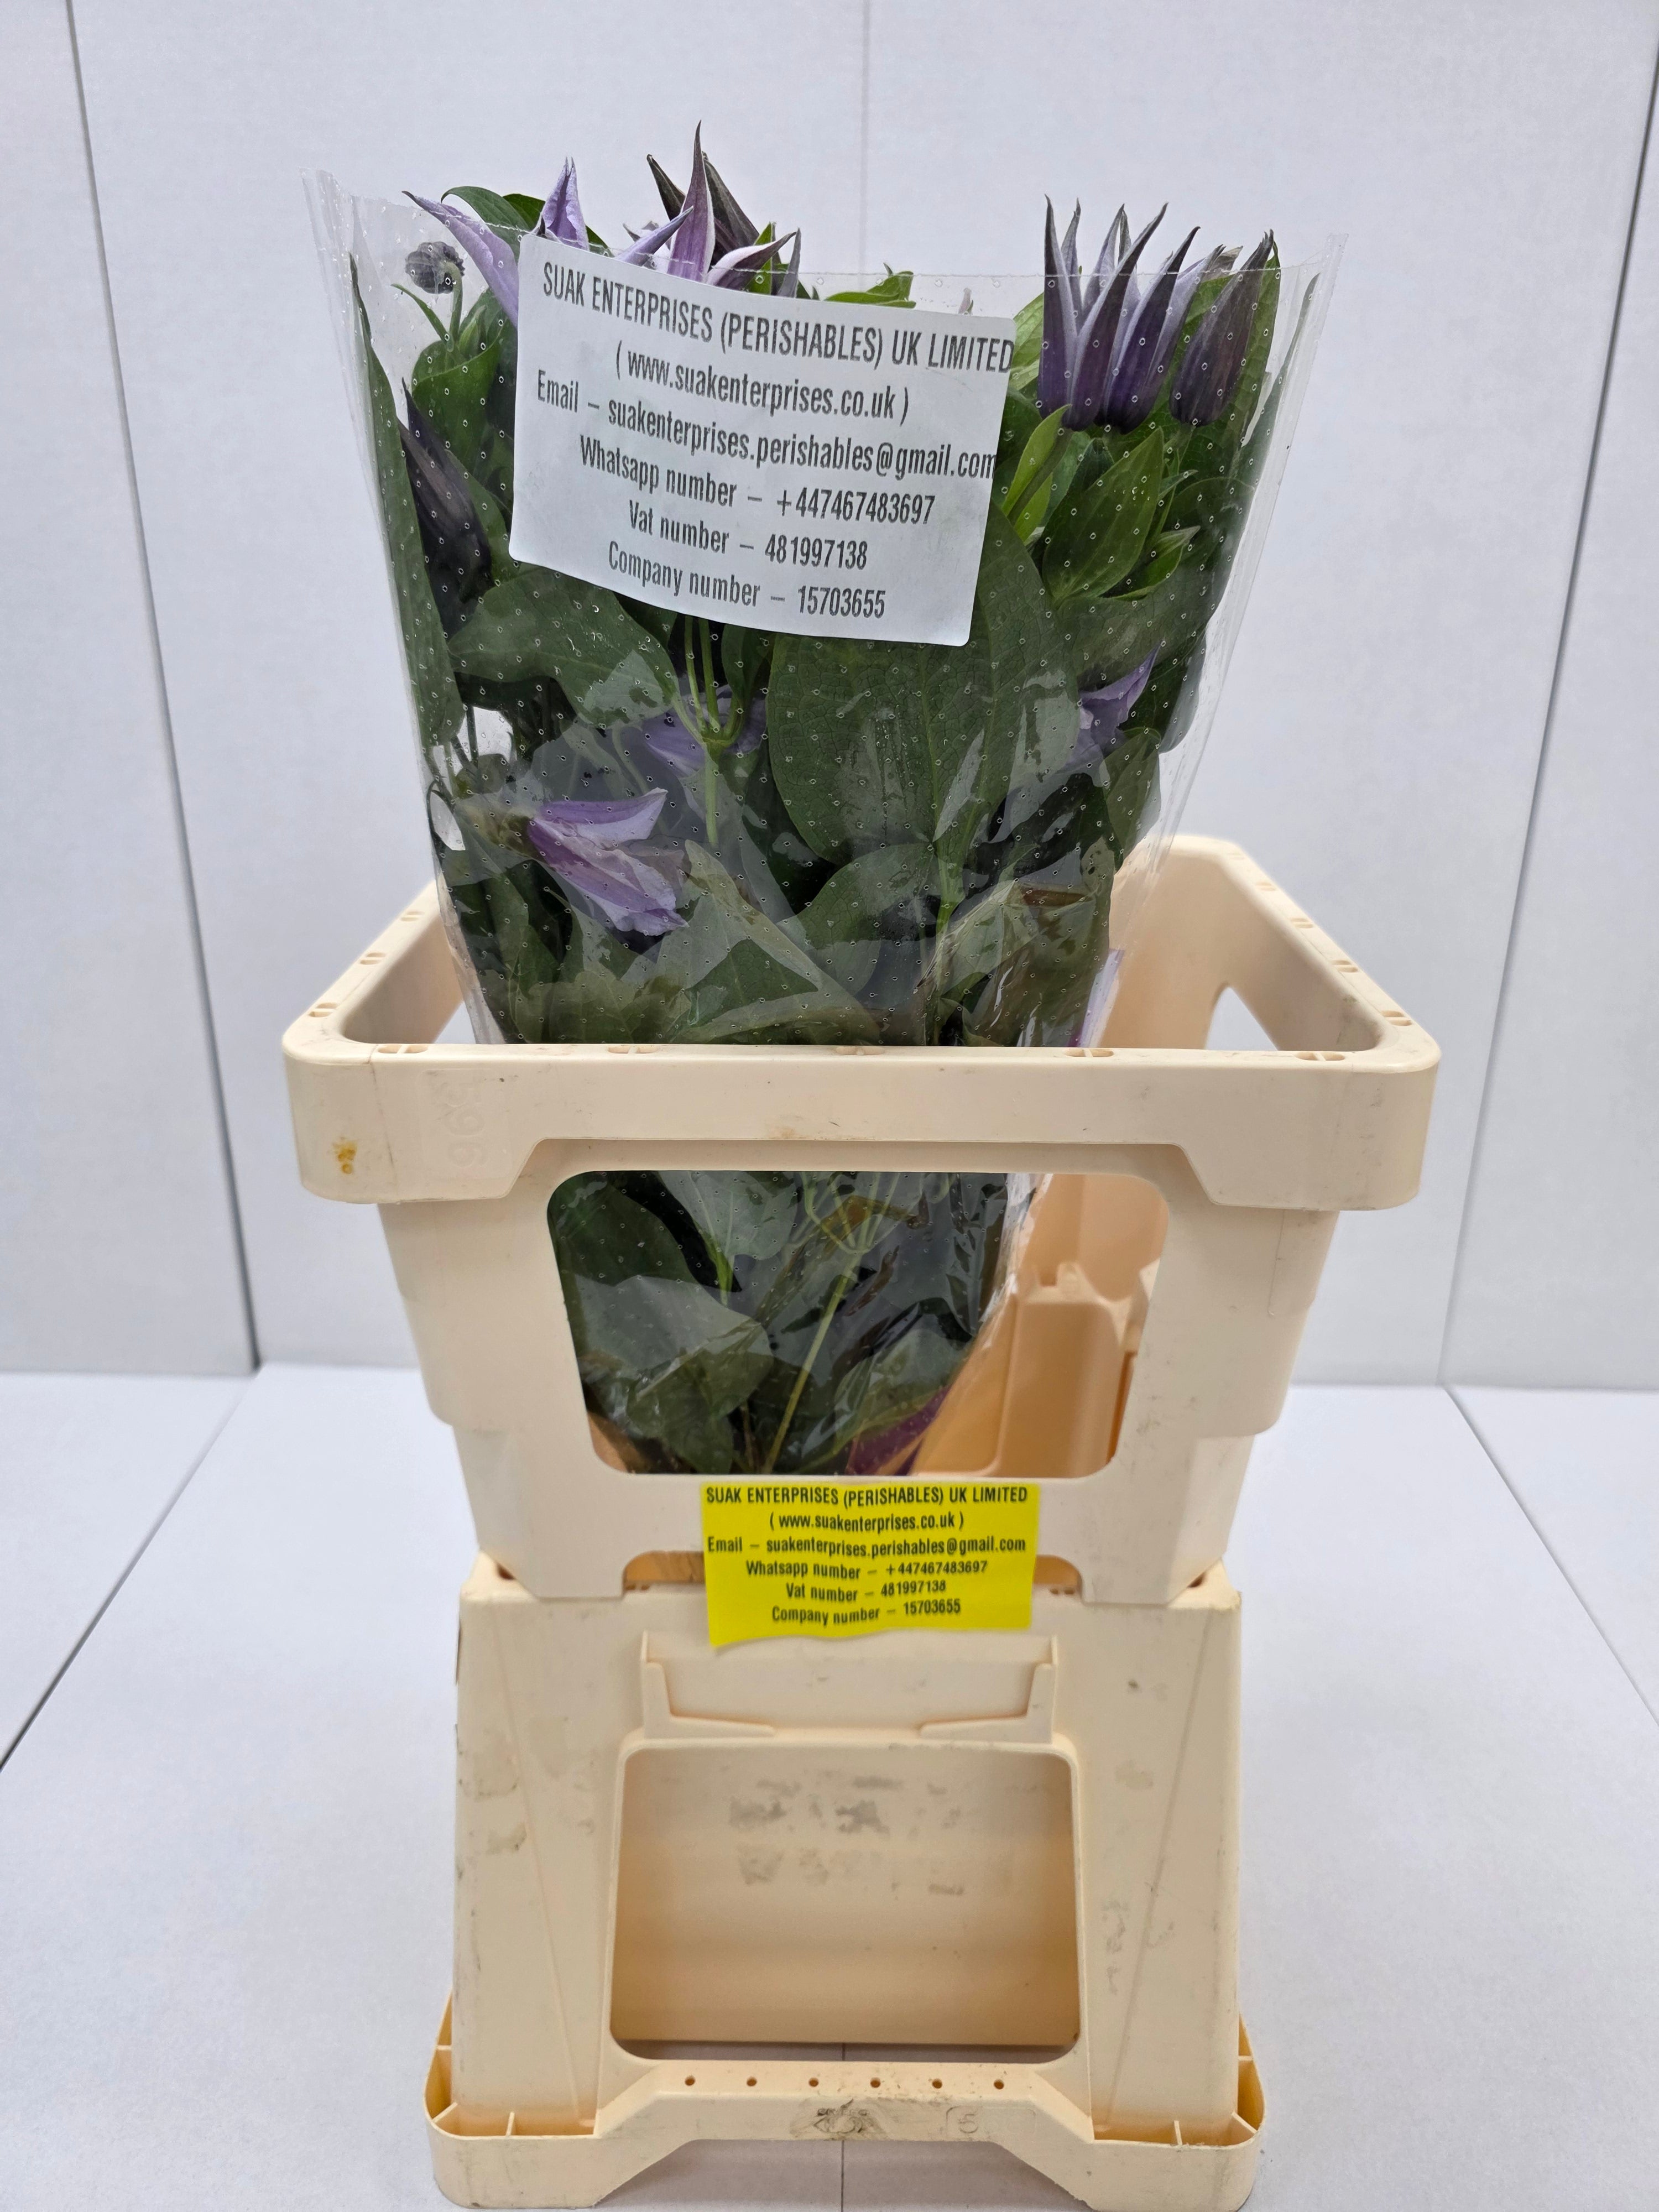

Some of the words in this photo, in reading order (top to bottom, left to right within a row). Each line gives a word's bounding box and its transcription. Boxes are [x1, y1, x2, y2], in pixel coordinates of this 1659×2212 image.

[544, 262, 585, 306] SUAK
[593, 276, 712, 342] ENTERPRISES
[721, 312, 882, 370] (PERISHABLES)
[892, 330, 922, 366] UK
[928, 333, 1015, 373] LIMITED
[628, 351, 895, 419] www.suakenterprises.co.uk
[538, 369, 578, 413] Email
[608, 398, 997, 481] suakenterprises.perishables@gmail.com
[580, 435, 659, 494] Whatsapp
[666, 469, 737, 507] number
[629, 500, 653, 535] Vat
[660, 517, 729, 554] number
[765, 534, 867, 570] 481997138
[609, 541, 682, 596] Company
[690, 573, 760, 607] number
[798, 586, 885, 618] 15703655
[707, 1487, 741, 1503] SUAK
[748, 1487, 838, 1505] ENTERPRISES
[844, 1487, 943, 1510] (PERISHABLES)
[950, 1487, 967, 1503] UK
[973, 1487, 1027, 1502] LIMITED
[779, 1511, 954, 1534] www.suakenterprises.co.uk
[708, 1536, 742, 1552] Email
[767, 1536, 1025, 1559] suakenterprises.perishables@gmail.com
[747, 1561, 807, 1577] Whatsapp
[813, 1564, 860, 1579] number
[773, 1606, 828, 1626] Company
[834, 1608, 879, 1624] number
[904, 1599, 961, 1615] 15703655
[786, 1583, 805, 1598] Vat
[811, 1588, 857, 1601] number
[881, 1580, 946, 1597] 481997138
